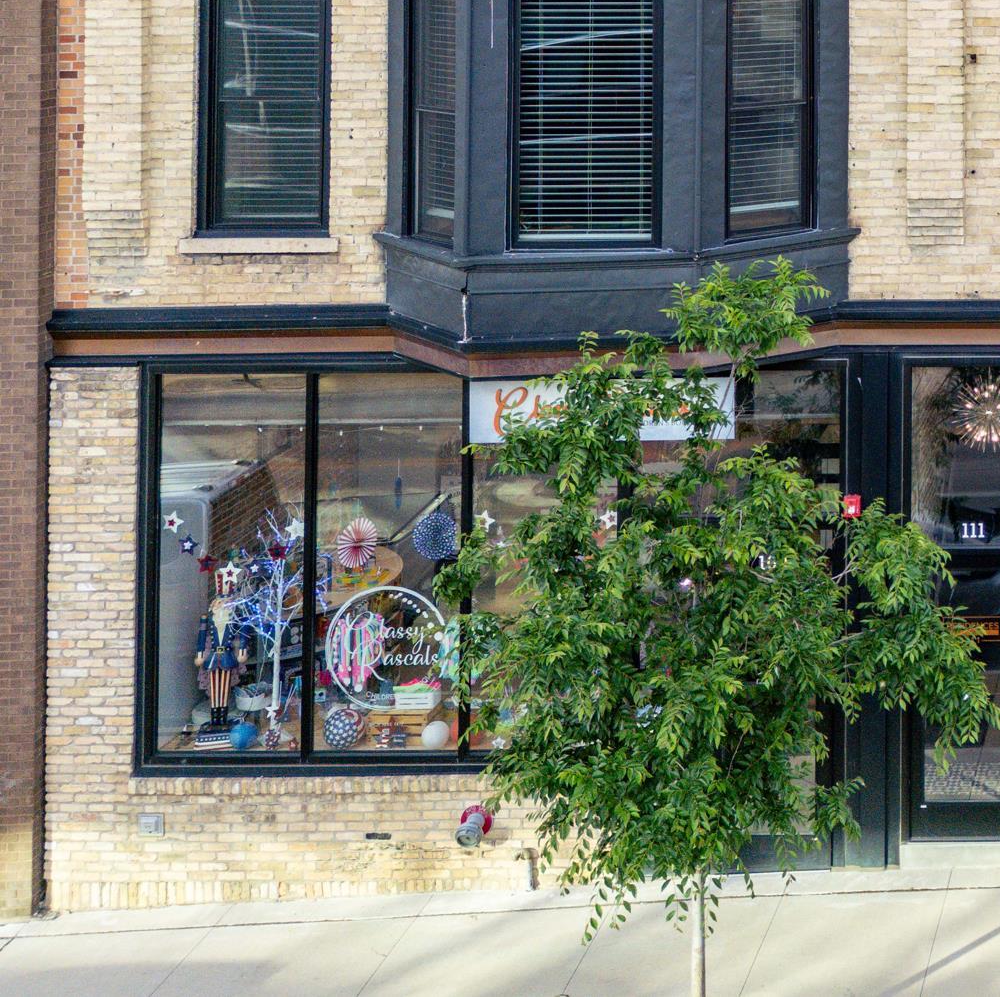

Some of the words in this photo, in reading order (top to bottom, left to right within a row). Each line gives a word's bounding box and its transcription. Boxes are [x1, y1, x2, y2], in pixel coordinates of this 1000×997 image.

[962, 522, 985, 538] 111
[344, 611, 425, 653] Classy
[351, 639, 440, 681] Rascals
